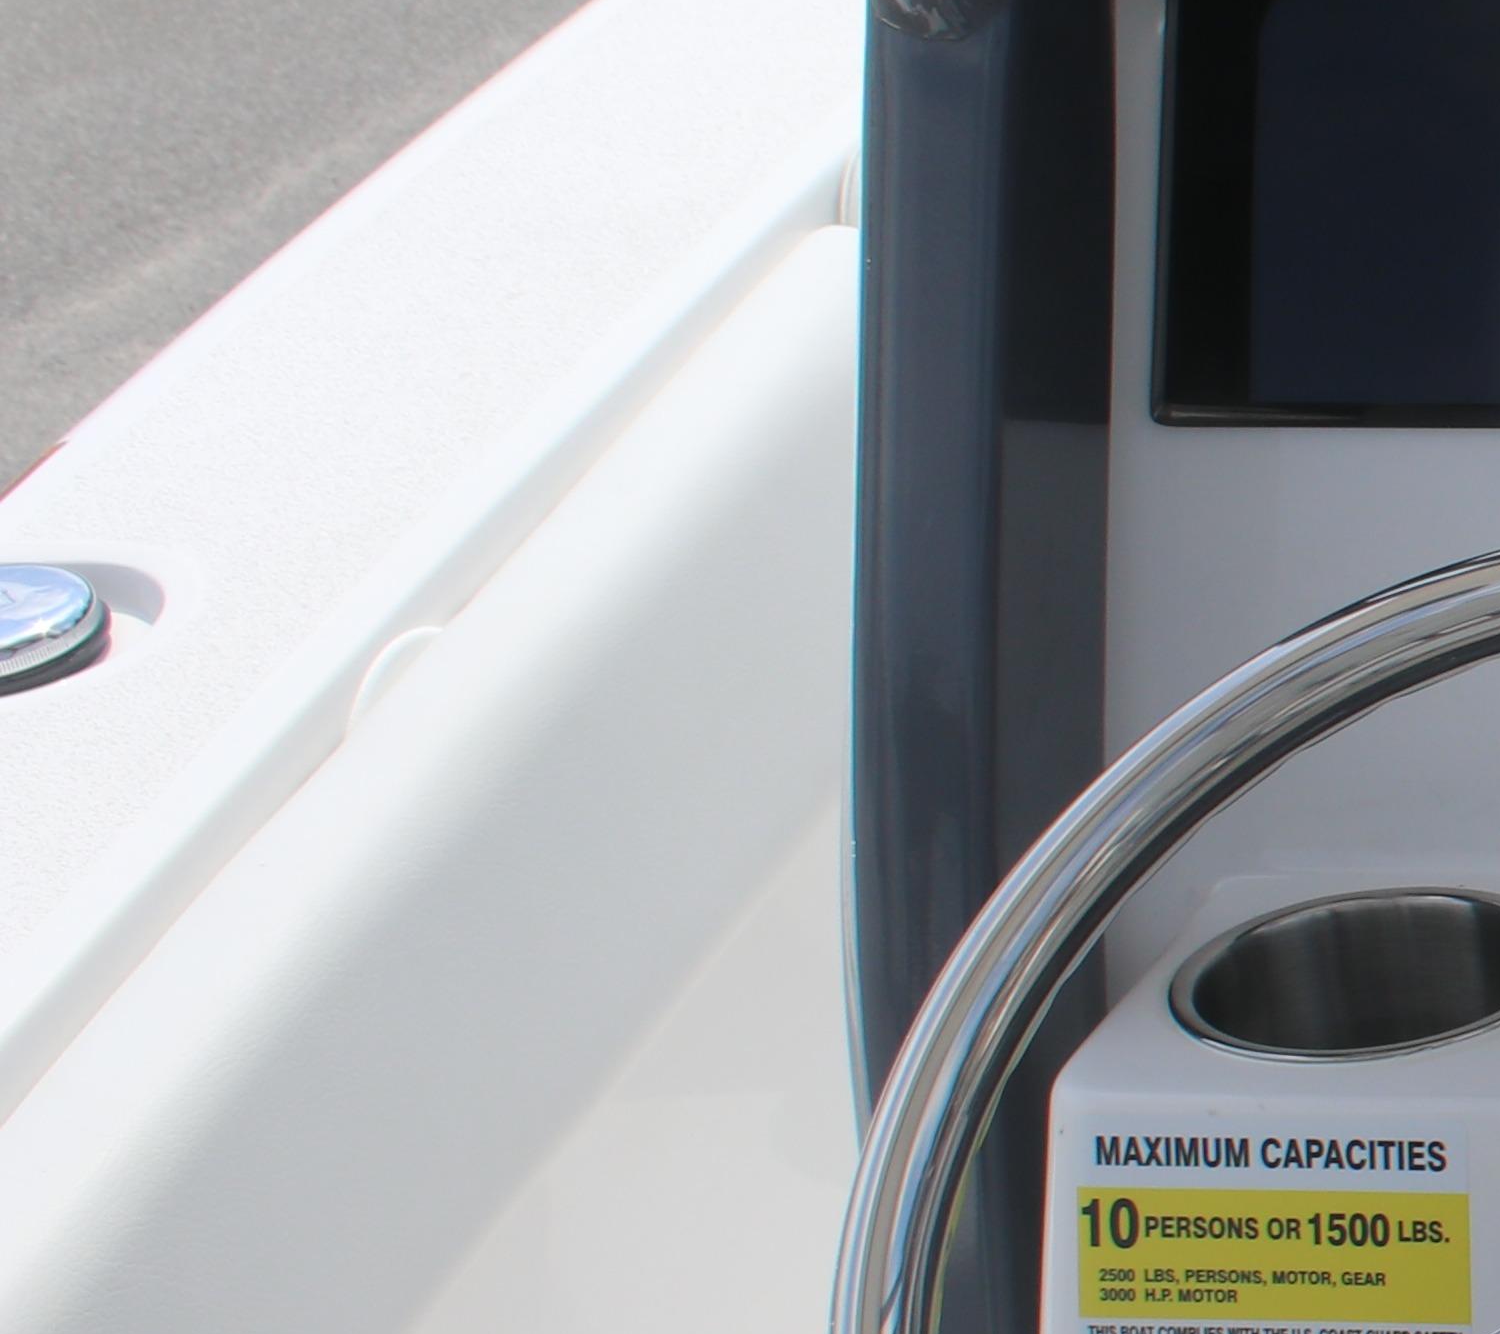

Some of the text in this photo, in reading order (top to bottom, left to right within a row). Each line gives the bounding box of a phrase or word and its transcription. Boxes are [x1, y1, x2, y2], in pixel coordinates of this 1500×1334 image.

[1095, 1135, 1447, 1172] MAXIMUM CAPACITIES
[1081, 1197, 1451, 1249] 10 PERSONS OR 1500 LBS.
[1098, 1268, 1387, 1288] 2500 LBS, PERSONS, MOTOR, GEAR
[1099, 1287, 1238, 1304] 3000 H.P. MOTOR
